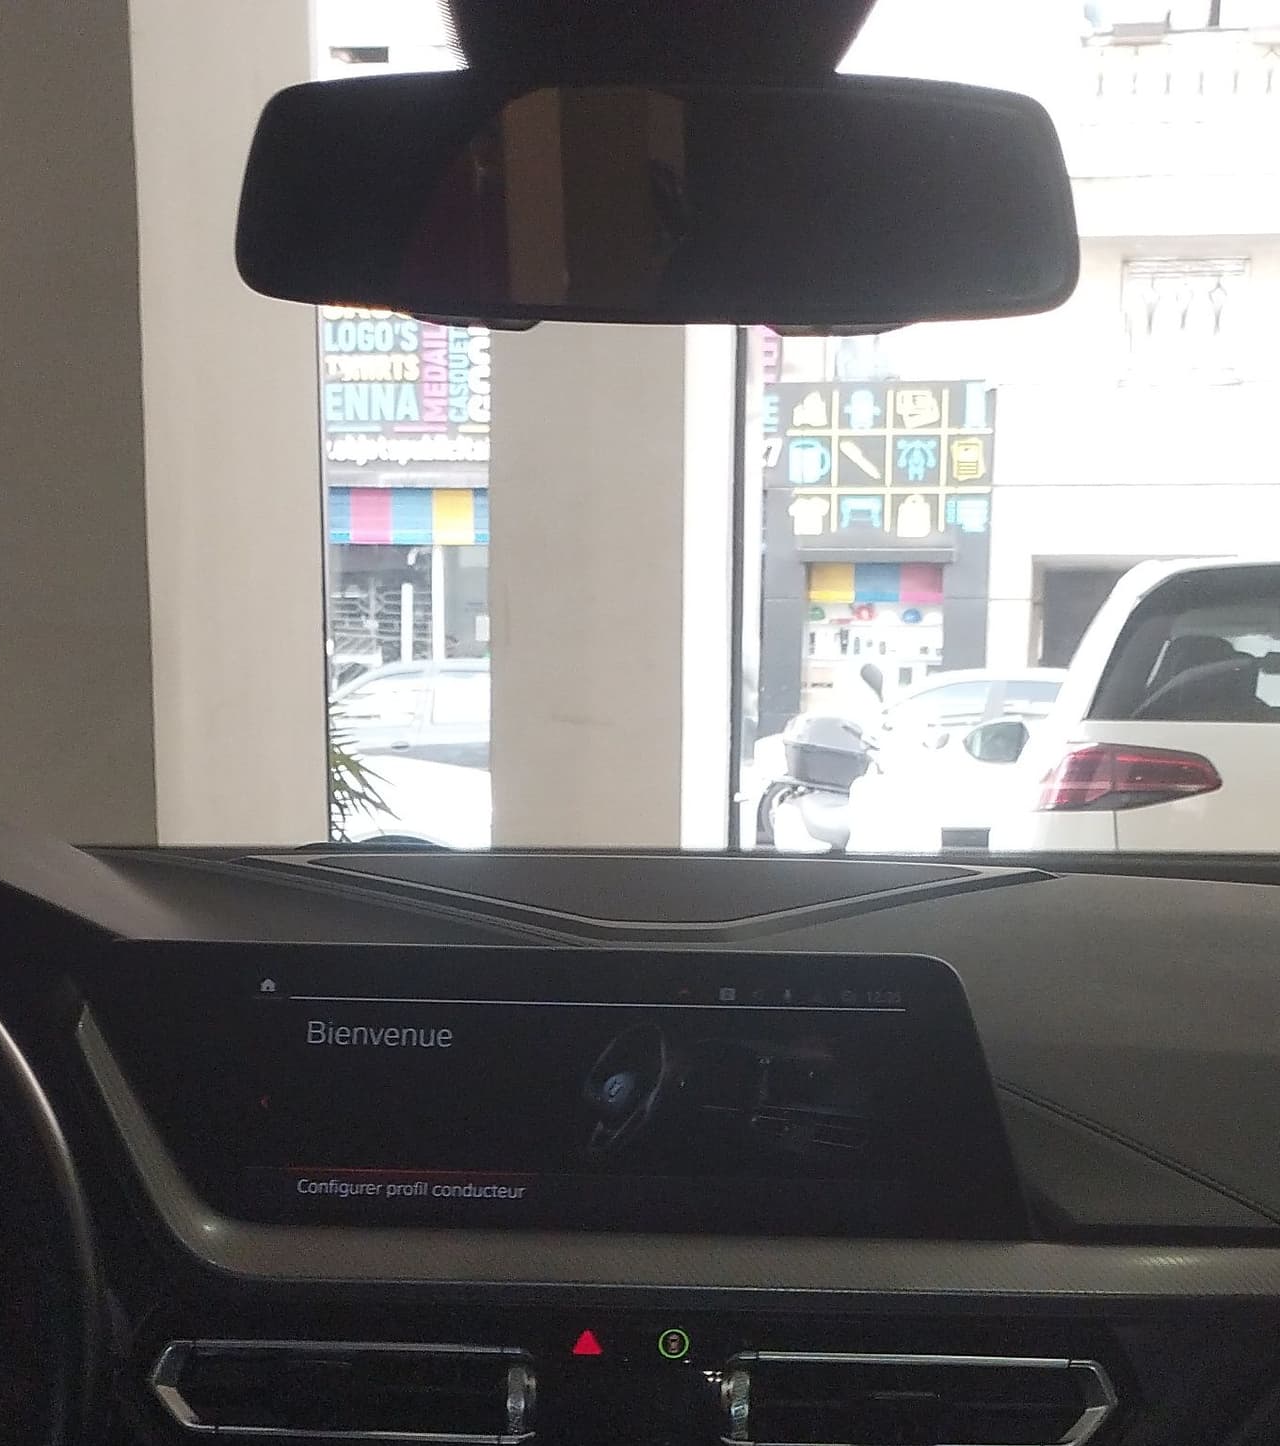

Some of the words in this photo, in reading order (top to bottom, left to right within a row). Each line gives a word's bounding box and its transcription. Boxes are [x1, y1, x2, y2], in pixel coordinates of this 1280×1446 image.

[324, 321, 419, 352] LOGO'S
[325, 384, 420, 421] ENNA
[306, 1020, 454, 1048] Bienvenue
[297, 1178, 382, 1197] Configurer
[386, 1182, 428, 1197] profil
[432, 1183, 526, 1199] conducteur
